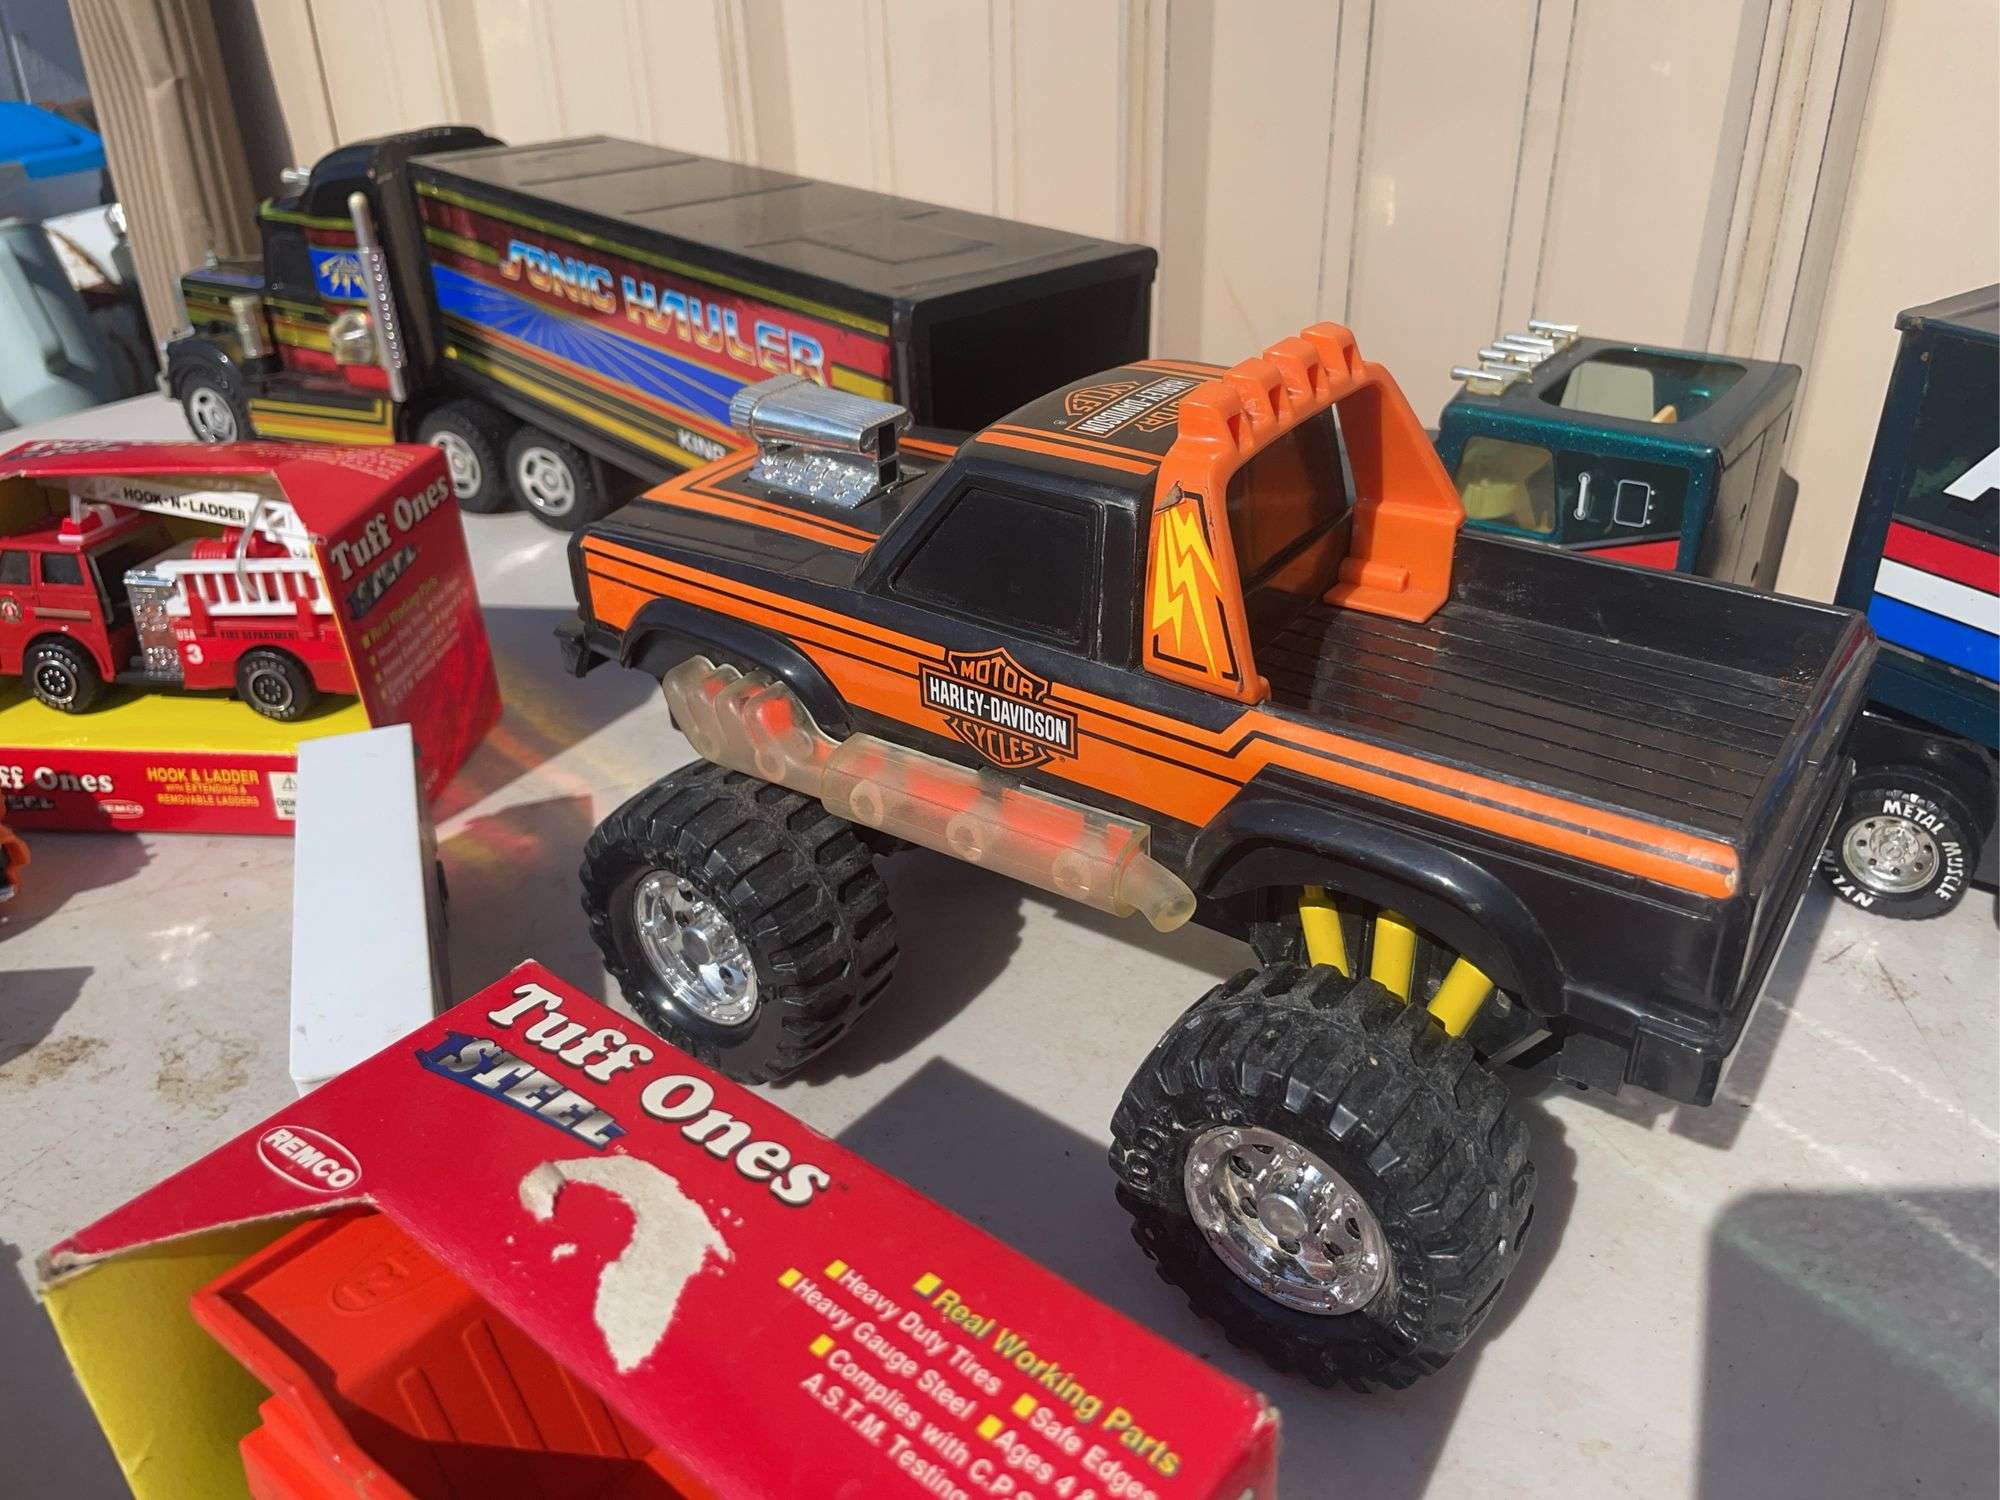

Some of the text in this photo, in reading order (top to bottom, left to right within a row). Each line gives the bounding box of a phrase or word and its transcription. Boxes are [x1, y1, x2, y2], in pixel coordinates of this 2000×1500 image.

[499, 239, 830, 388] SONIC HAULER
[1077, 379, 1196, 434] HARLEY-DAVIDSON
[330, 476, 449, 581] Tuff Ones
[186, 643, 204, 665] 3
[960, 656, 1035, 699] MOTOR
[929, 676, 1067, 746] HARLEY-DAVIDSON
[961, 720, 1035, 763] CYCLES
[34, 766, 114, 793] Ones
[147, 767, 260, 785] HOOK & LADDER
[1882, 799, 1964, 900] METAL MUSCLE
[438, 1035, 627, 1147] STEEL
[487, 983, 832, 1207] Tuff Ones
[263, 1127, 357, 1190] REMCO
[792, 1277, 977, 1420] Heavy Gauge Steel
[839, 1269, 1002, 1395] Heavy Duty Tires
[800, 1373, 887, 1446] A.S.T.M.
[827, 1349, 922, 1430] Complies
[921, 1423, 971, 1466] with
[932, 1289, 1181, 1477] Real Working Parts
[993, 1430, 1077, 1498] Ages 4
[1029, 1406, 1083, 1455] Safe
